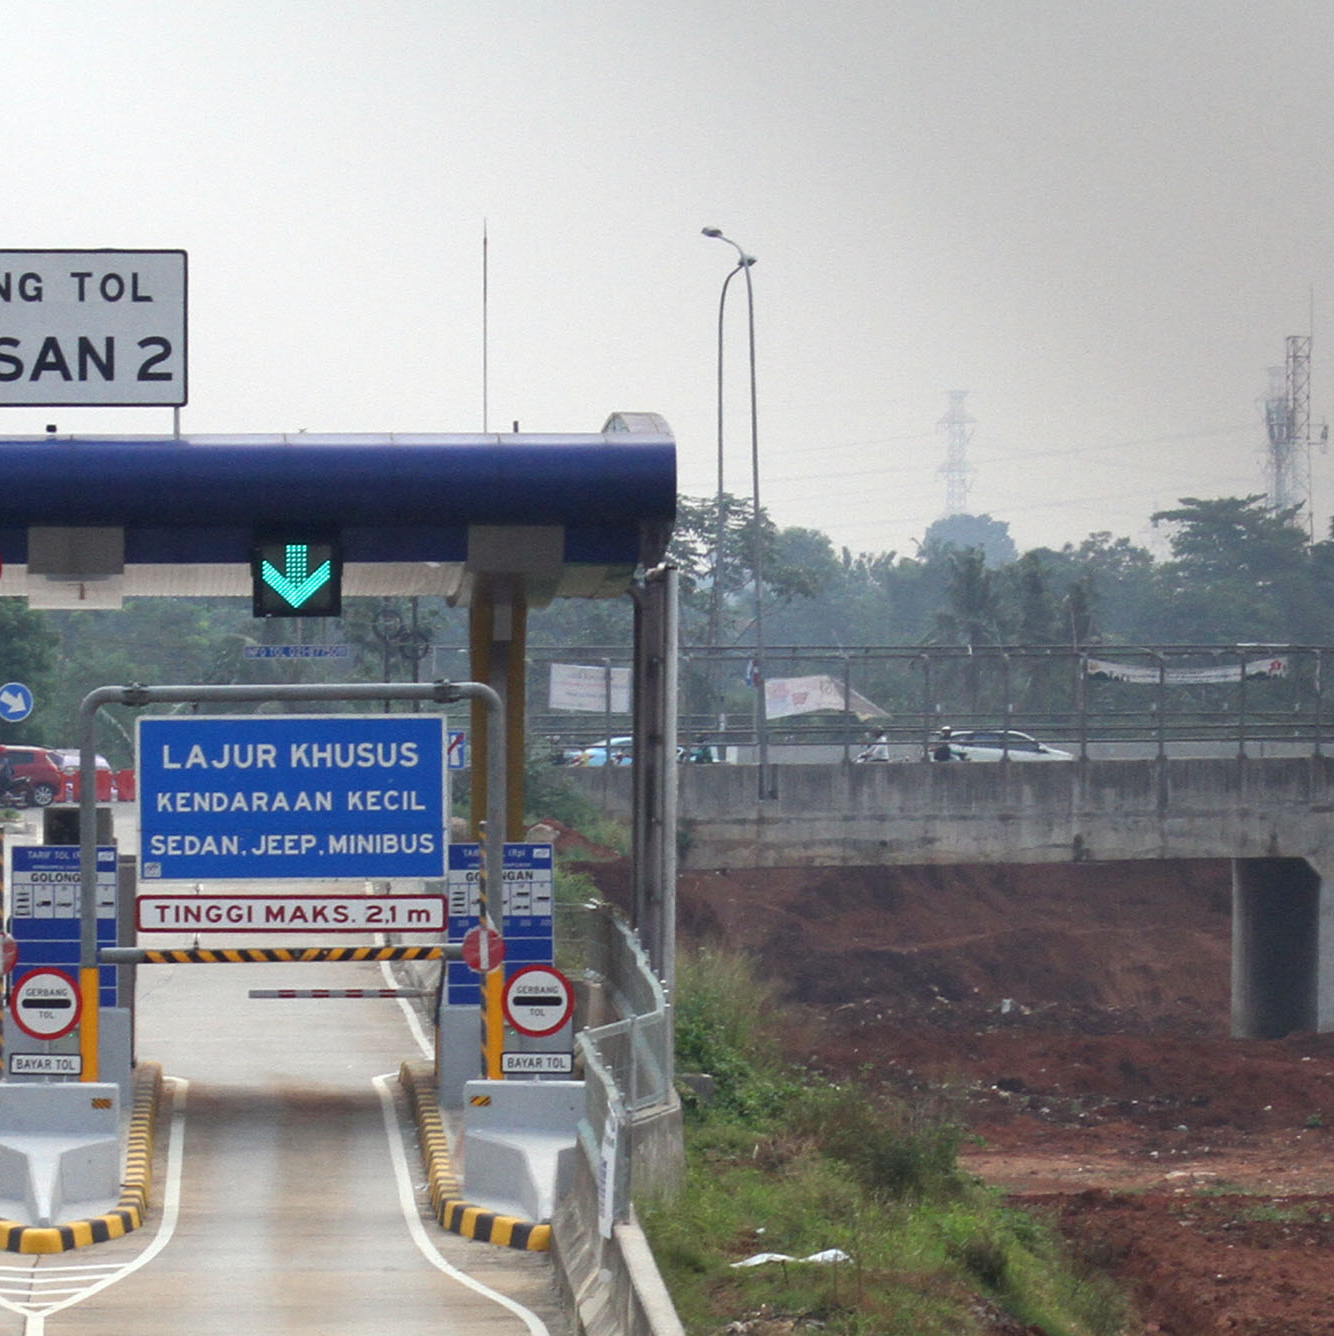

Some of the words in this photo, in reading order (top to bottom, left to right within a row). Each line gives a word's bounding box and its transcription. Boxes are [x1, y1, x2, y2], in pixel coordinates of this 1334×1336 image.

[71, 272, 154, 303] TOL
[137, 336, 173, 381] 2
[162, 743, 278, 769] LAJUR
[290, 742, 419, 768] KHUSUS
[156, 791, 333, 812] KENDARAAN
[347, 789, 427, 811] KECIL
[328, 833, 435, 855] MINIBUS
[154, 904, 254, 924] TINGGI
[264, 904, 357, 924] MAKS.
[365, 904, 397, 926] 2,1
[407, 907, 431, 924] m
[25, 987, 68, 997] GERBANG
[516, 985, 559, 994] GERBANG
[38, 1010, 55, 1019] TOL
[529, 1008, 546, 1017] TOL
[16, 1058, 52, 1070] BAYAR
[56, 1059, 76, 1071] TOL
[507, 1057, 543, 1069] BAYAR
[547, 1057, 566, 1069] TOL
